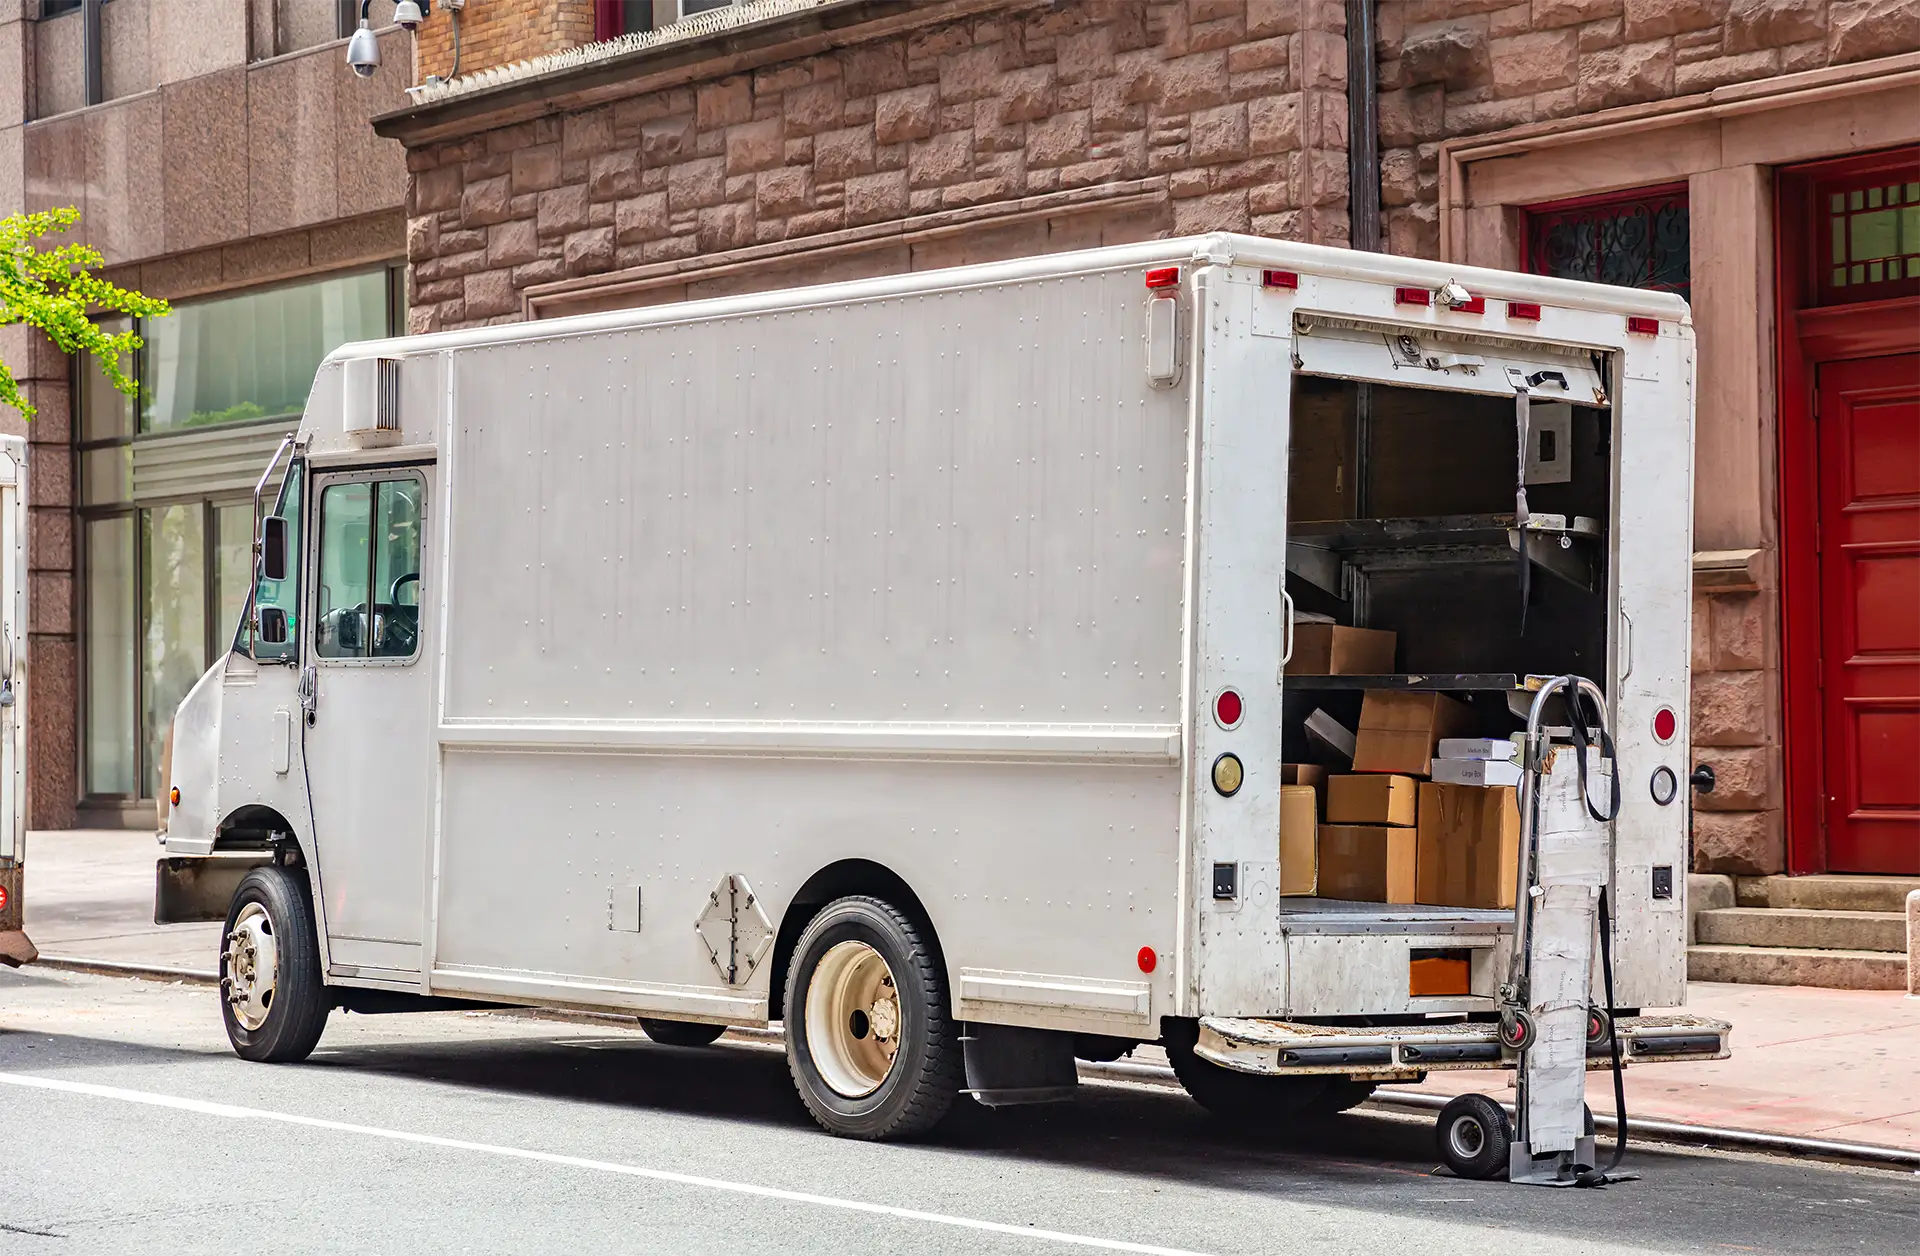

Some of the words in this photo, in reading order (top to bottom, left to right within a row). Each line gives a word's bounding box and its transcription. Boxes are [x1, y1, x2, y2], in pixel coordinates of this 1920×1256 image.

[1462, 770, 1474, 779] Large
[1474, 770, 1482, 778] Box
[1561, 775, 1569, 789] Box
